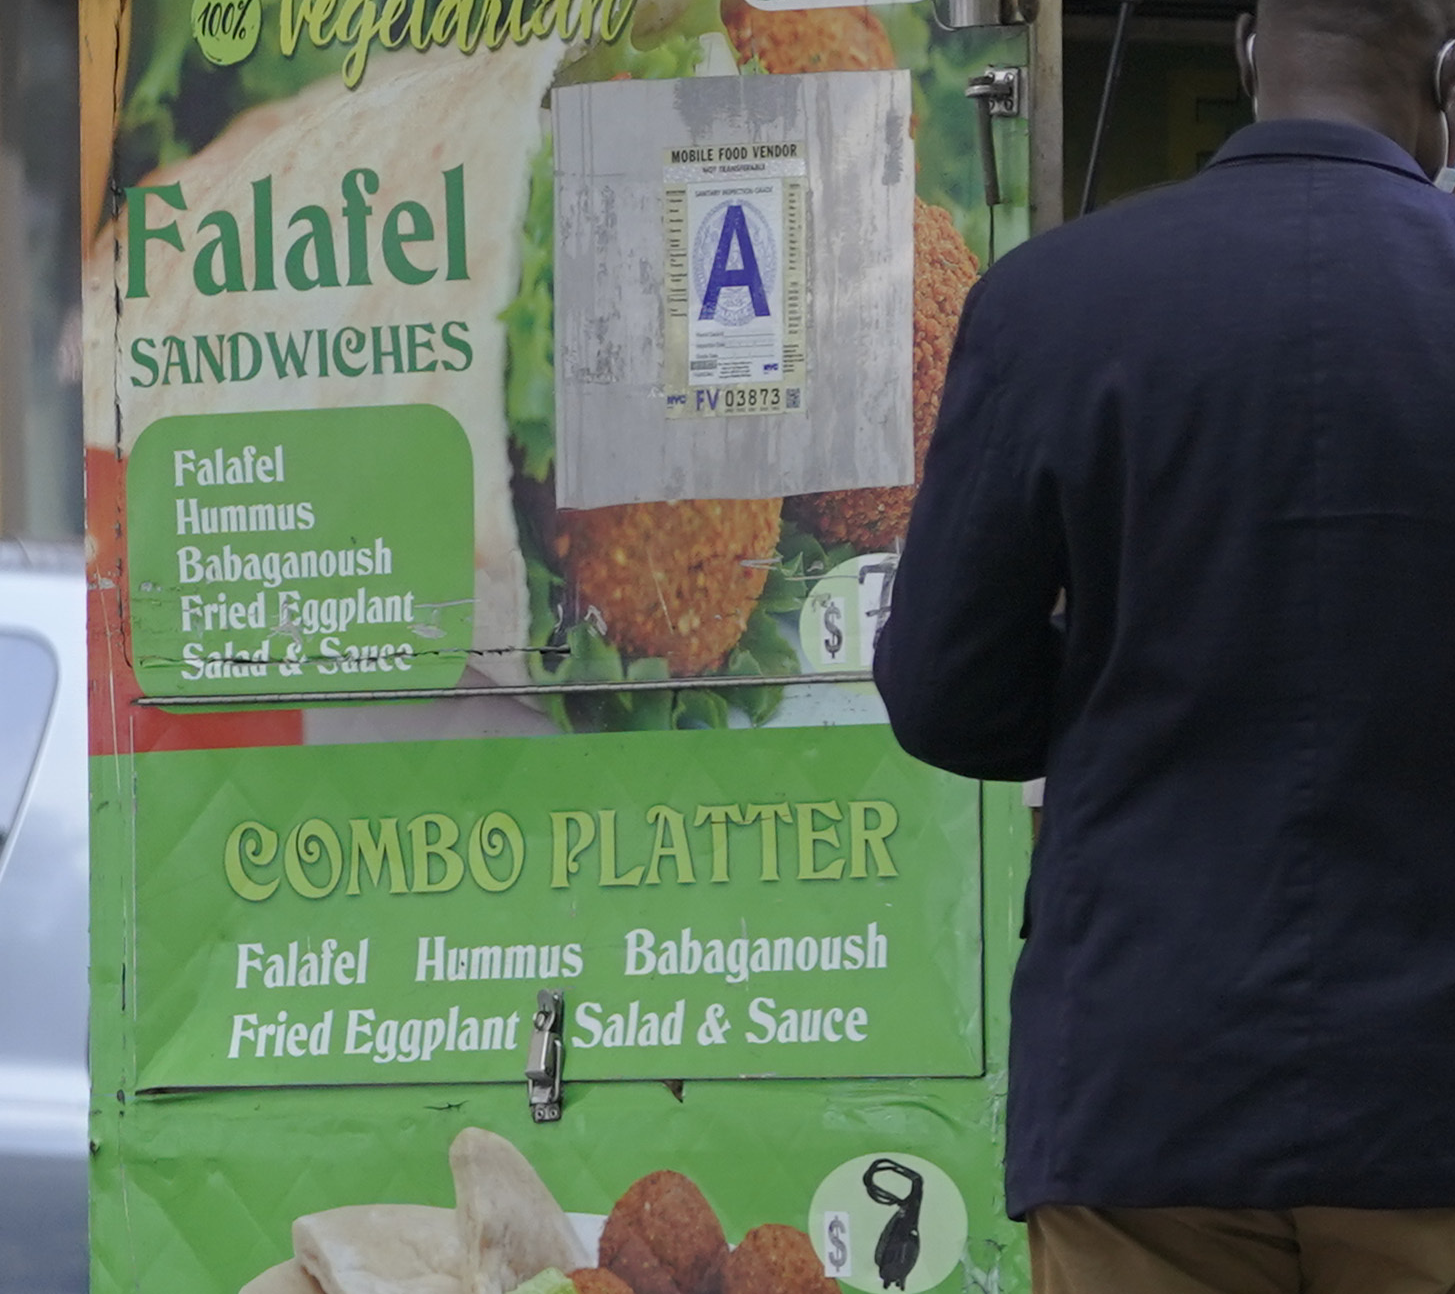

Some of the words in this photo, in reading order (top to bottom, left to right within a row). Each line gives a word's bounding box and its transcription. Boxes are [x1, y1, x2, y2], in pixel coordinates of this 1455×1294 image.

[671, 148, 714, 164] MOBILE
[718, 146, 748, 161] FOOD
[752, 143, 798, 158] VENDOR
[123, 164, 473, 303] Falafel
[698, 204, 771, 321] A
[130, 320, 474, 389] SANDWICHES
[696, 389, 720, 412] FV
[725, 388, 781, 407] 03873
[173, 446, 286, 488] Falafel
[175, 497, 316, 537] Hummus
[176, 537, 393, 588] Babaganoush
[180, 591, 267, 633] Fried
[278, 588, 415, 634] Eggplant
[180, 640, 267, 681] Salad
[276, 643, 304, 678] &
[316, 637, 414, 675] Sauce
[223, 809, 526, 903] COMBO
[549, 799, 901, 890] PLATTER
[235, 937, 370, 990] Falafel
[415, 937, 584, 984] Hummus
[624, 922, 889, 983] Babaganoush
[228, 1009, 331, 1060] Fried
[344, 1005, 519, 1064] Eggplant
[572, 1001, 688, 1050] Salad
[697, 1005, 727, 1046] &
[745, 997, 869, 1045] Sauce
